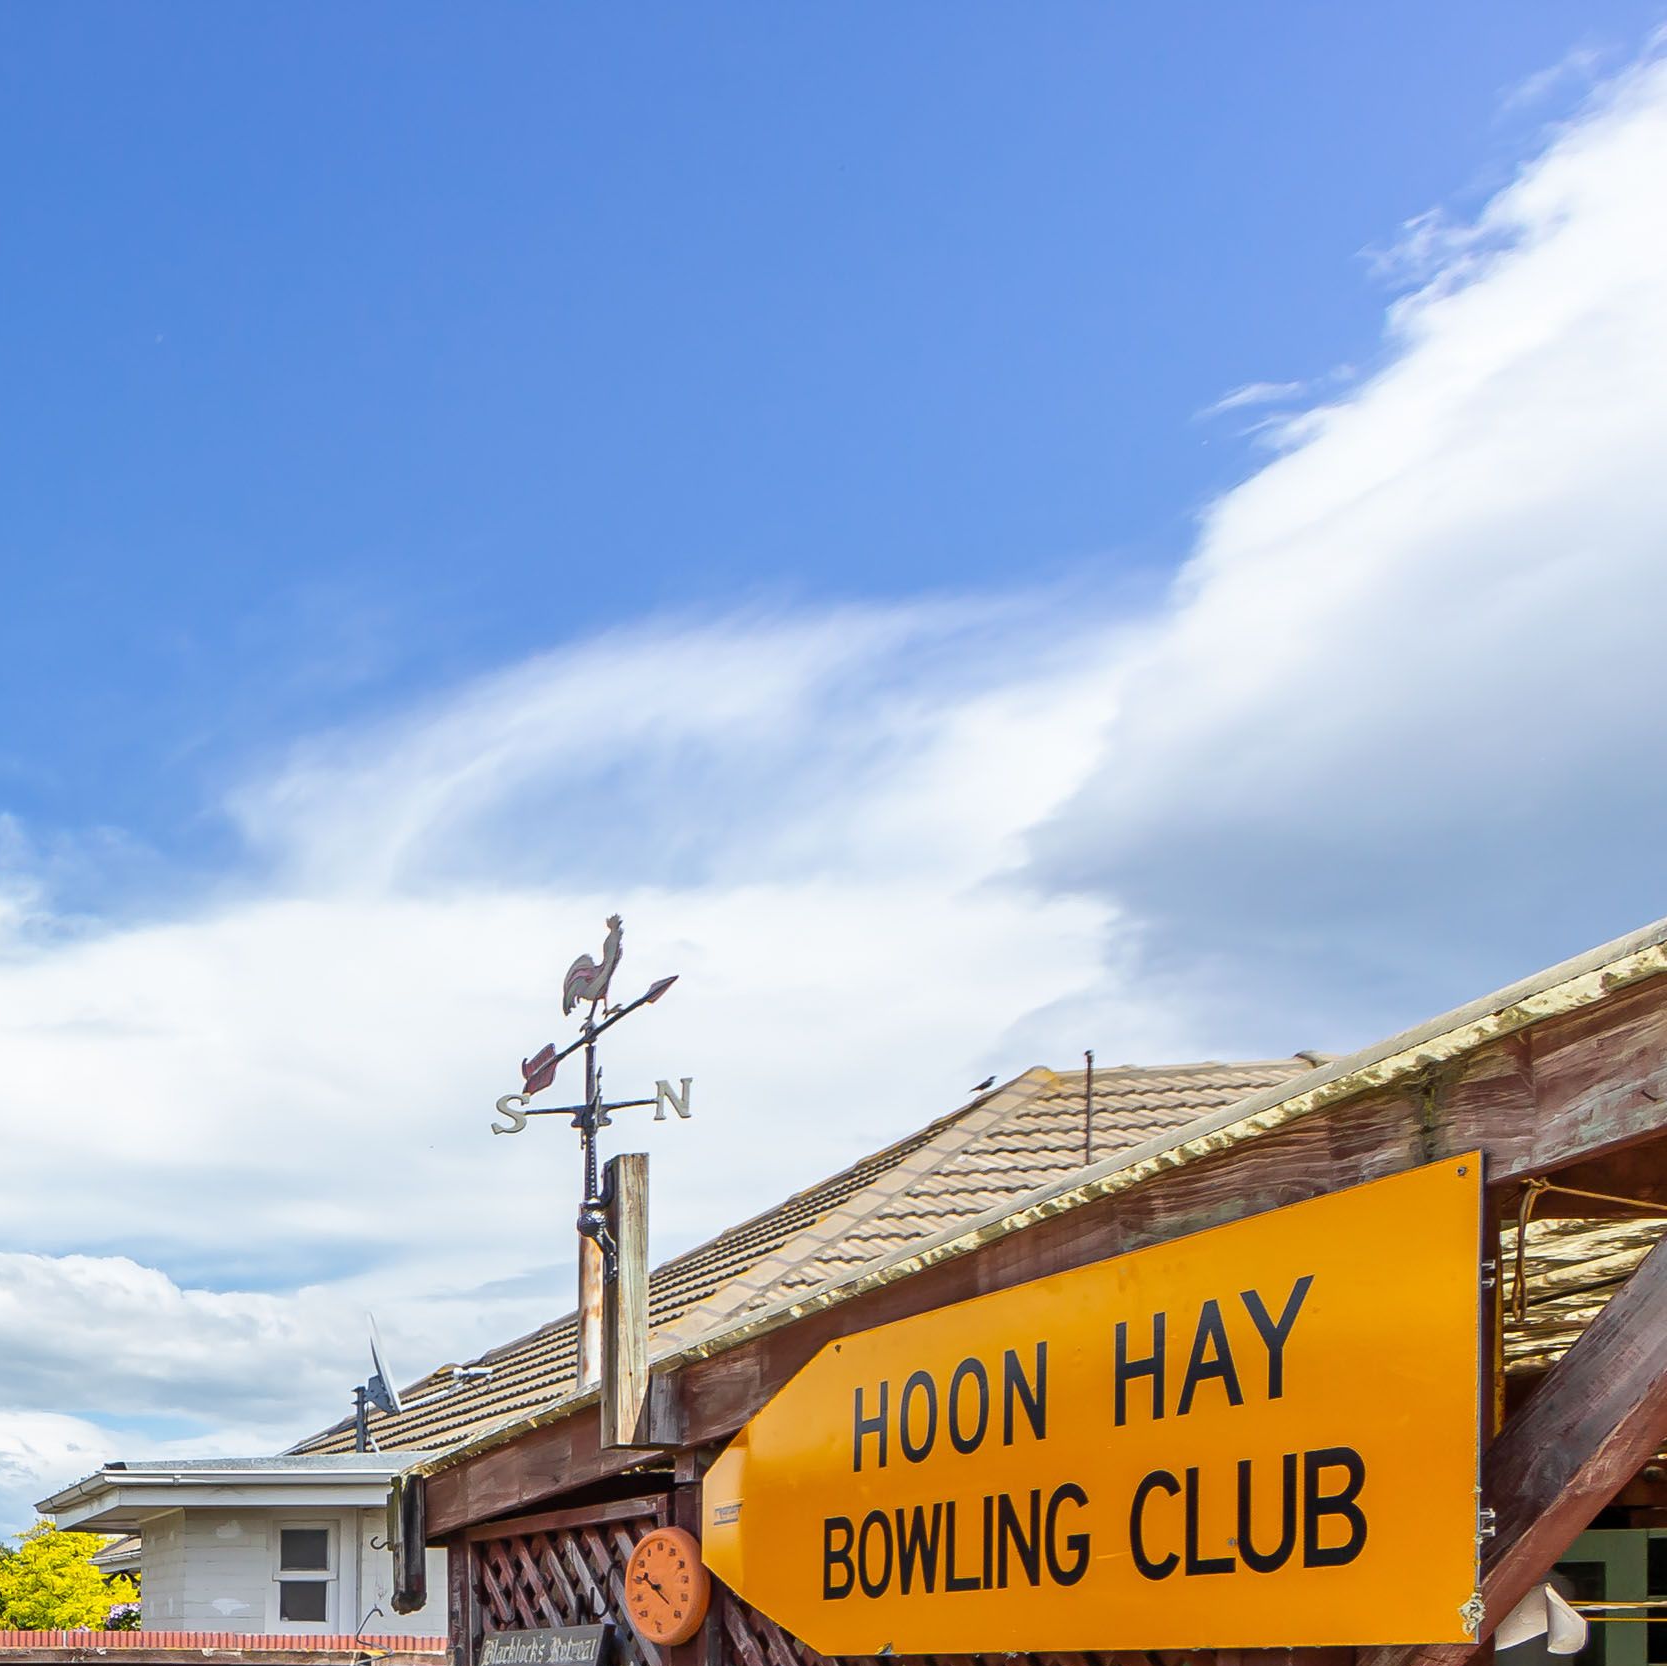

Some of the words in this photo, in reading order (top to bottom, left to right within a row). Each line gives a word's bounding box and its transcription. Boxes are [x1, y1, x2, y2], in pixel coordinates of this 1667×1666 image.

[491, 1094, 531, 1134] S
[654, 1077, 693, 1120] N
[853, 1341, 1048, 1473] HOON
[1115, 1274, 1315, 1427] HAY
[823, 1482, 1091, 1601] BOWLING
[1129, 1446, 1368, 1581] CLUB
